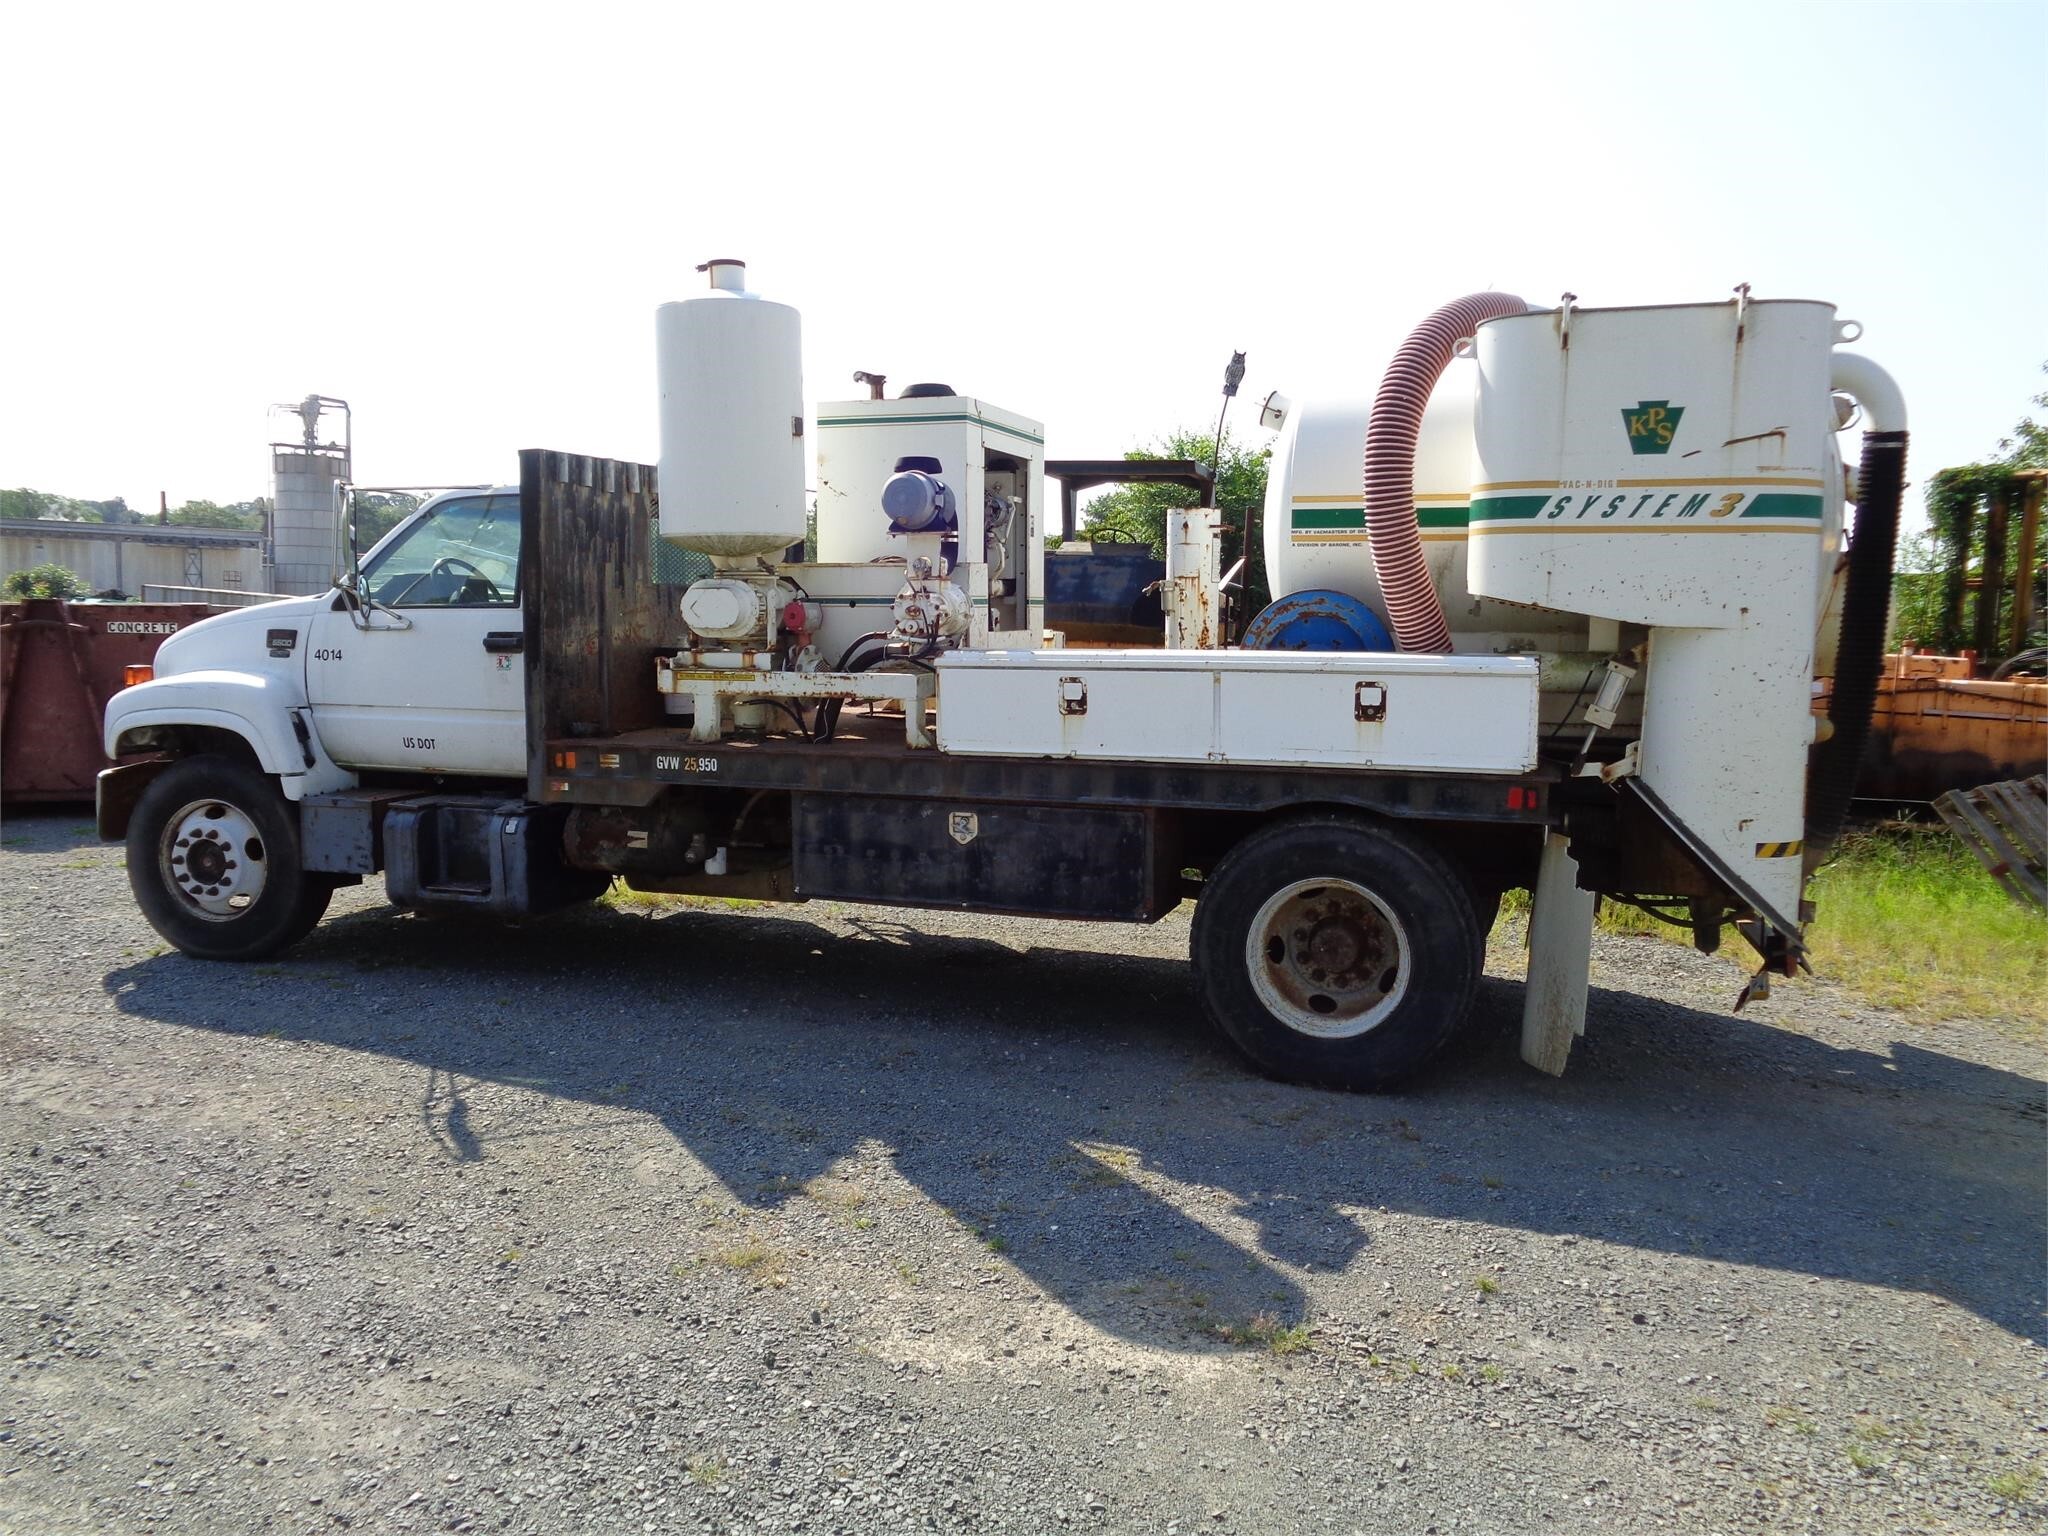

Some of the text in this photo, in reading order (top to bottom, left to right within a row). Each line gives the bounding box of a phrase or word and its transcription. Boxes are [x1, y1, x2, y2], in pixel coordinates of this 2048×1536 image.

[1629, 407, 1673, 445] KPS
[1562, 479, 1613, 489] VAC-N-DIG
[1547, 492, 1745, 519] SYSTEM 3
[108, 622, 177, 633] CONCRETE
[314, 649, 342, 660] 4014
[403, 737, 435, 750] US DOT
[656, 756, 718, 773] GVW 25,950
